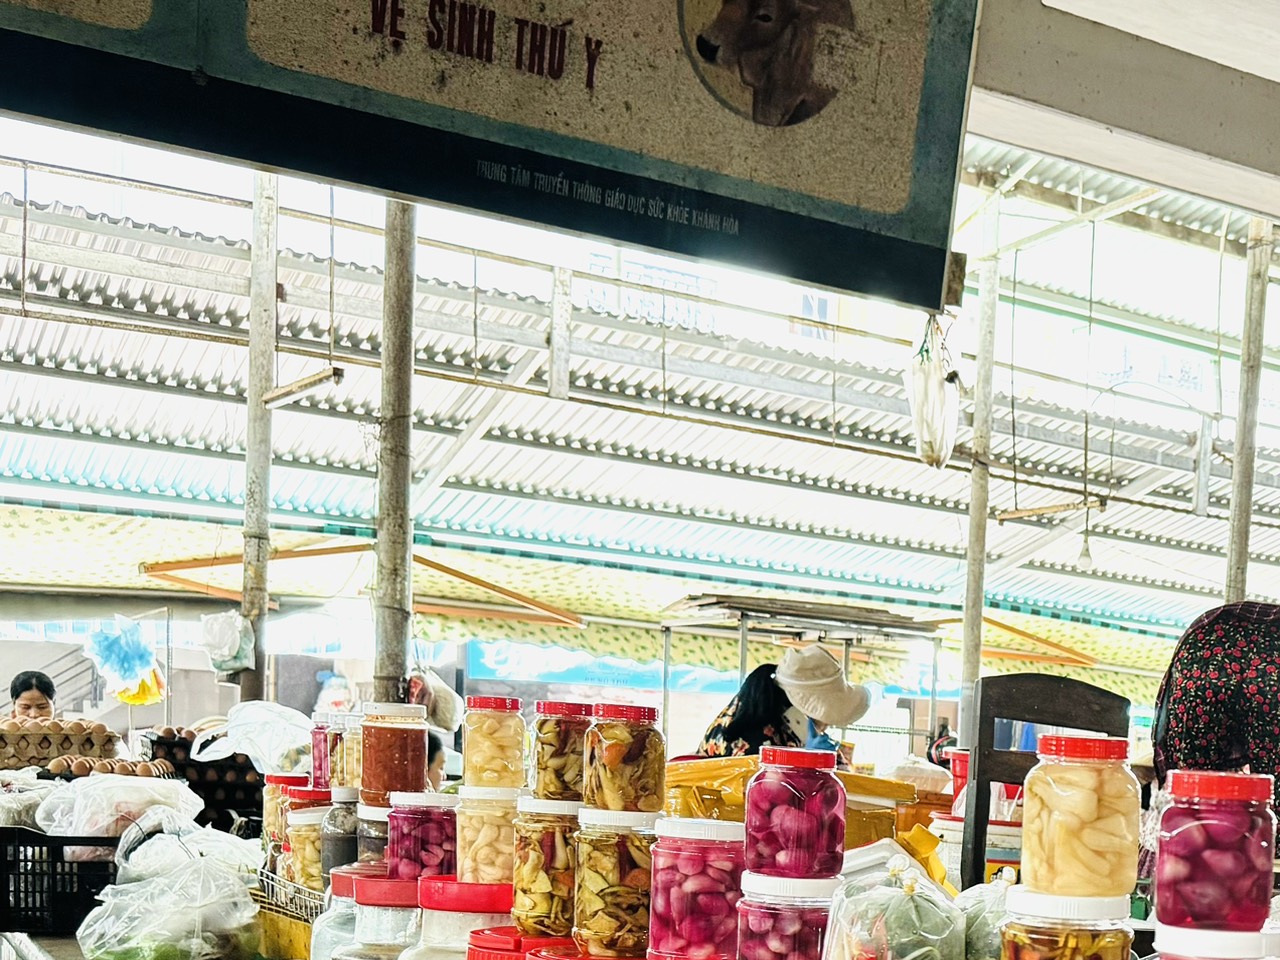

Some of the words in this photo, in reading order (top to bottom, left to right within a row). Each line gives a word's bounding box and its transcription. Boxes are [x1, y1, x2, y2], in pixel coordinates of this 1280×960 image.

[427, 0, 496, 63] SINH
[514, 17, 574, 80] THÚ
[584, 33, 603, 89] Y
[476, 160, 507, 182] TRUNG
